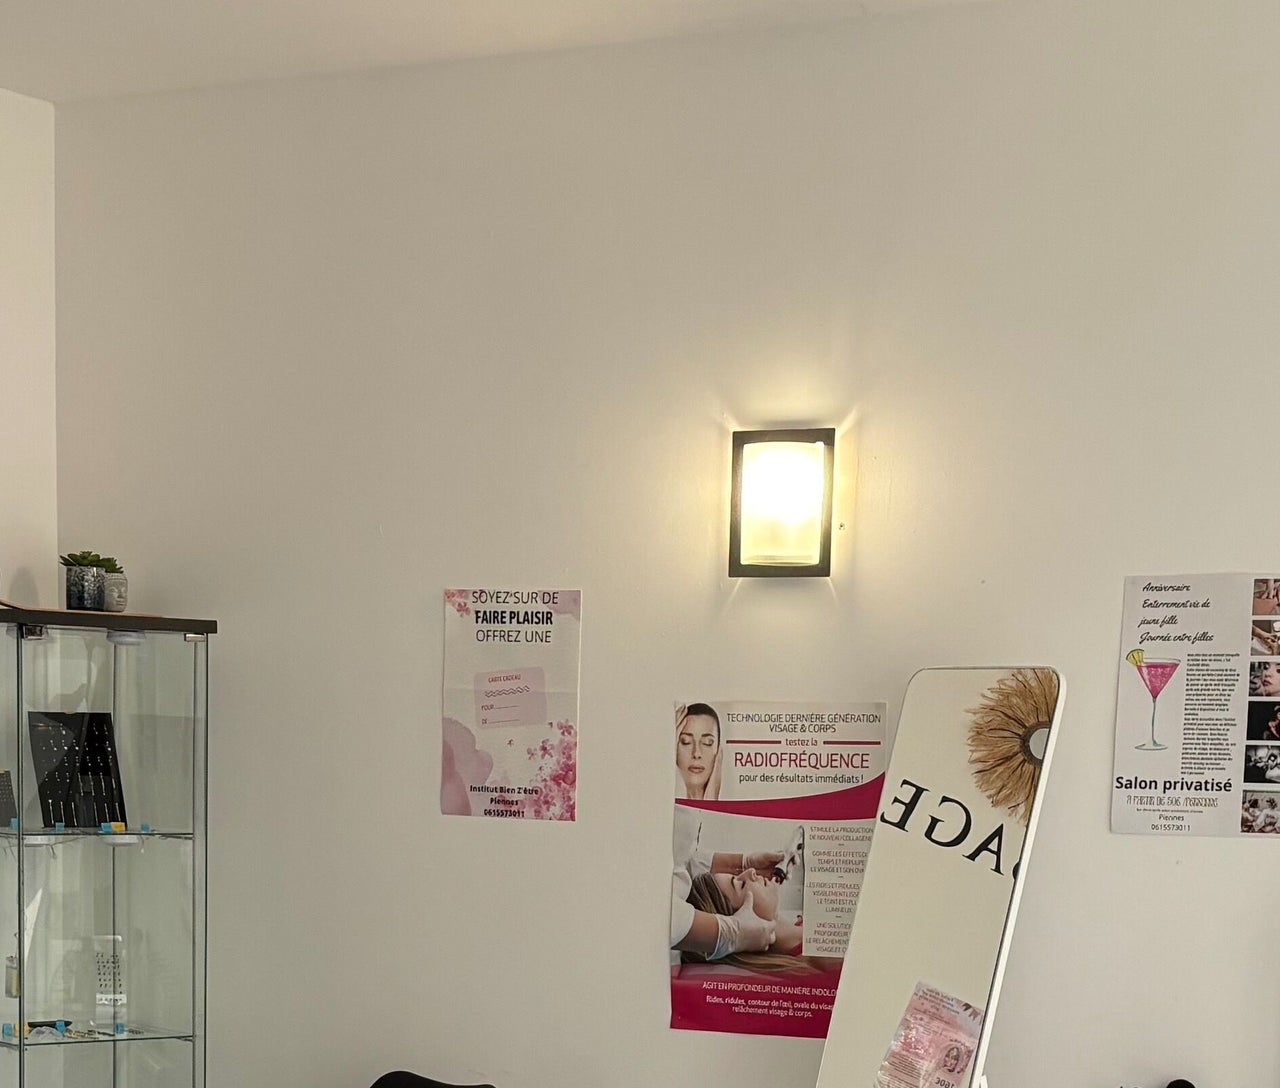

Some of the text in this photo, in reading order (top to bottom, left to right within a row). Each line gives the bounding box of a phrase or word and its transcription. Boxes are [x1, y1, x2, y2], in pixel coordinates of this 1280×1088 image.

[1142, 582, 1191, 592] Anniversaire
[472, 591, 510, 604] SOYEZ
[542, 592, 559, 604] DE
[1142, 598, 1210, 608] Enterrement vie de
[475, 610, 553, 625] FAIRE PLAISIR
[1138, 615, 1178, 628] jeune fille
[476, 630, 552, 643] OFFREZ UNE
[1173, 633, 1192, 641] entre
[1192, 632, 1214, 644] filles
[727, 713, 783, 723] TECHNOLOGIE
[828, 712, 881, 723] GÉNÉRATION
[769, 724, 837, 733] VISAGE & CORPS
[786, 738, 818, 747] testez la
[734, 750, 870, 770] RADIOFRÉQUENCE
[740, 774, 758, 784] pour
[760, 772, 774, 782] des
[776, 772, 813, 783] résultats
[470, 785, 498, 794] Institut
[500, 786, 516, 794] Bien
[1115, 776, 1232, 794] Salon privatisé
[728, 982, 771, 993] PROFONDEUR
[772, 986, 781, 994] DE
